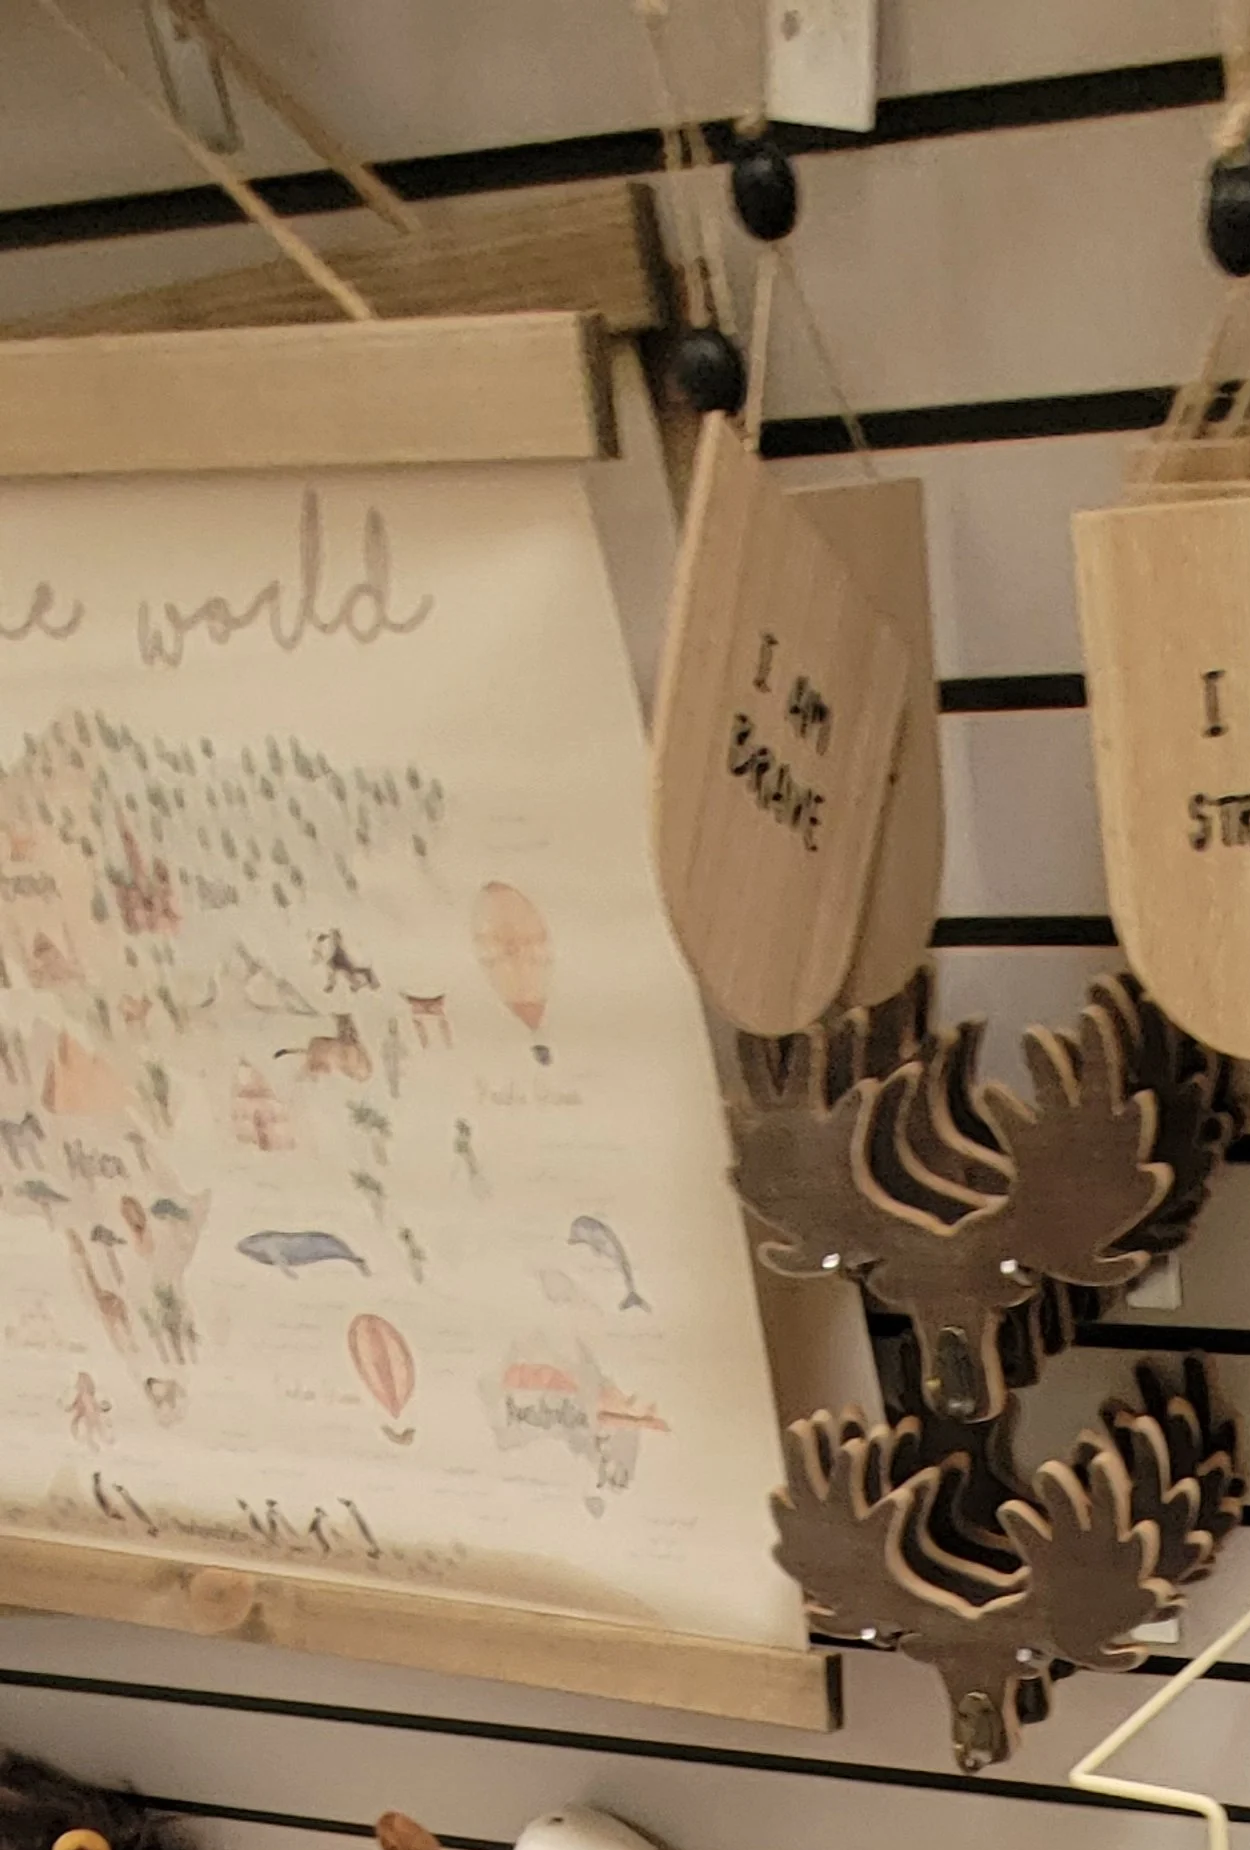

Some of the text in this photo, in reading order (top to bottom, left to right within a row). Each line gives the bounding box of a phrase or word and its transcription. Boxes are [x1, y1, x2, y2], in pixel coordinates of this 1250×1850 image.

[137, 483, 434, 668] world
[752, 633, 833, 755] I AM
[1201, 669, 1228, 738] I
[728, 713, 826, 852] BRAVE
